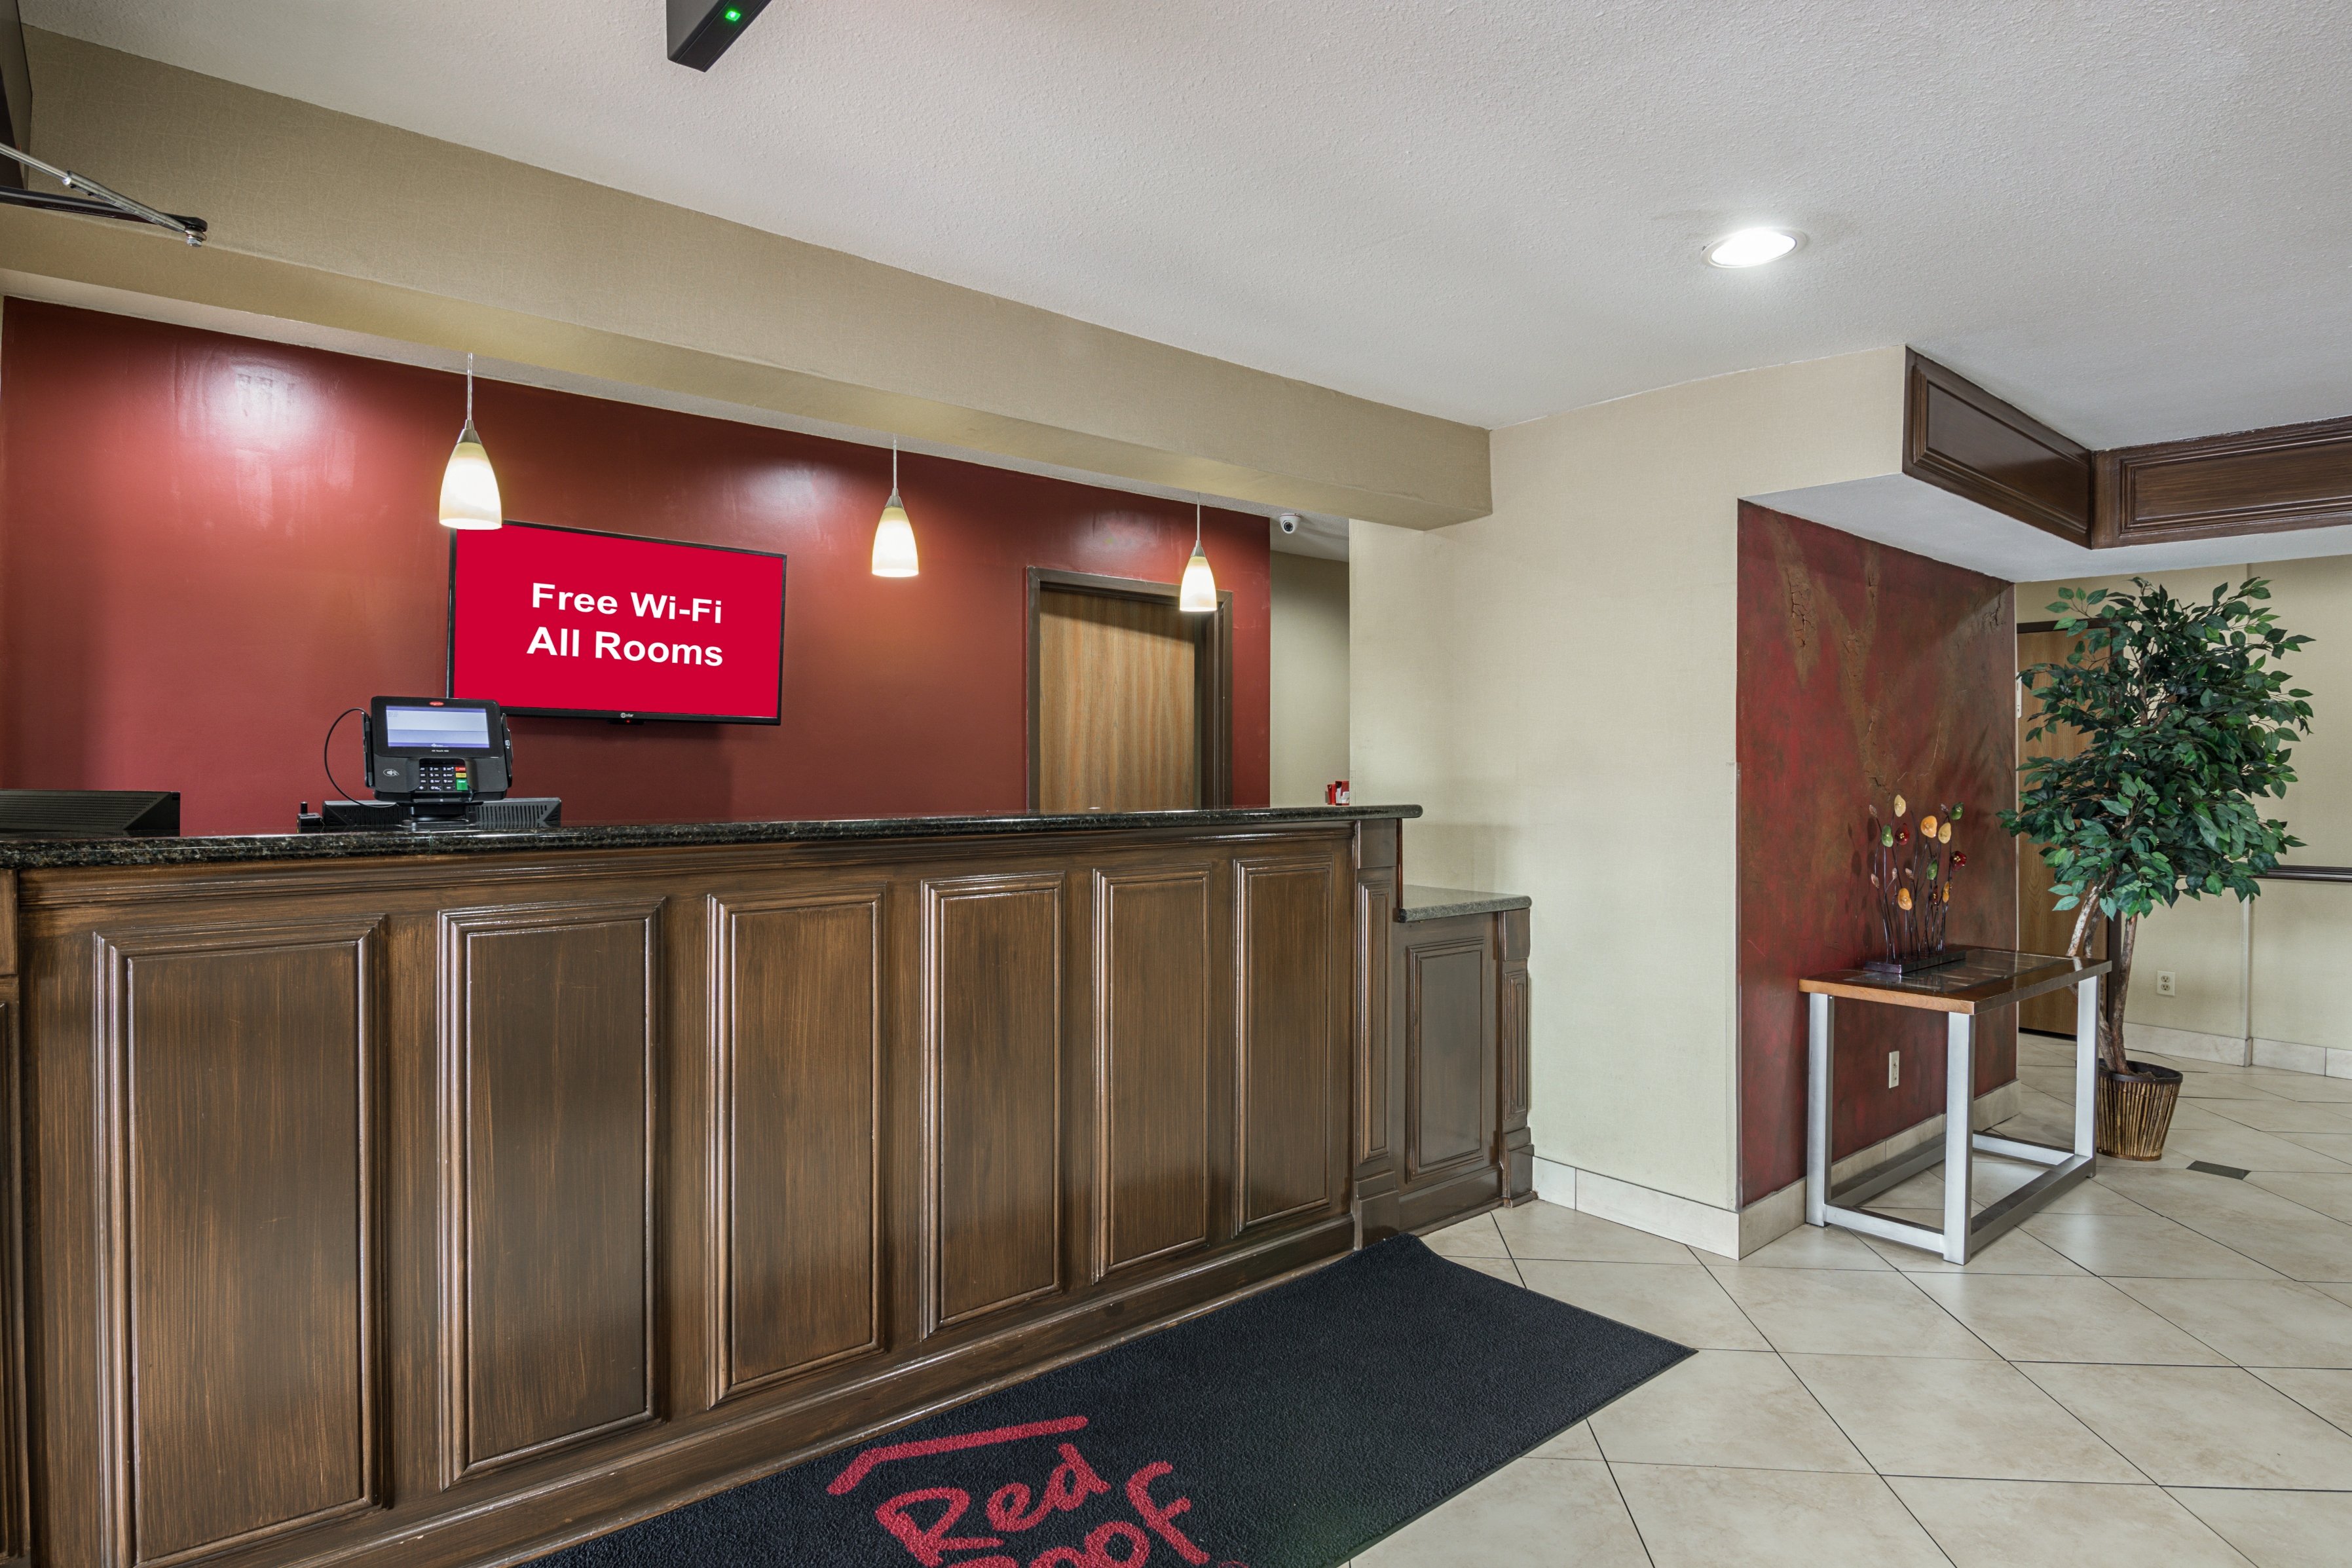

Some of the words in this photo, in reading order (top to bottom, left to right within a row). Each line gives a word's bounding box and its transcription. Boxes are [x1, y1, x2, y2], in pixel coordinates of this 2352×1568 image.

[532, 582, 618, 615] Free
[630, 591, 722, 624] Wi-Fi
[526, 626, 580, 657] All
[595, 631, 723, 667] Rooms
[875, 1442, 1111, 1567] Red
[946, 1461, 1210, 1568] of
